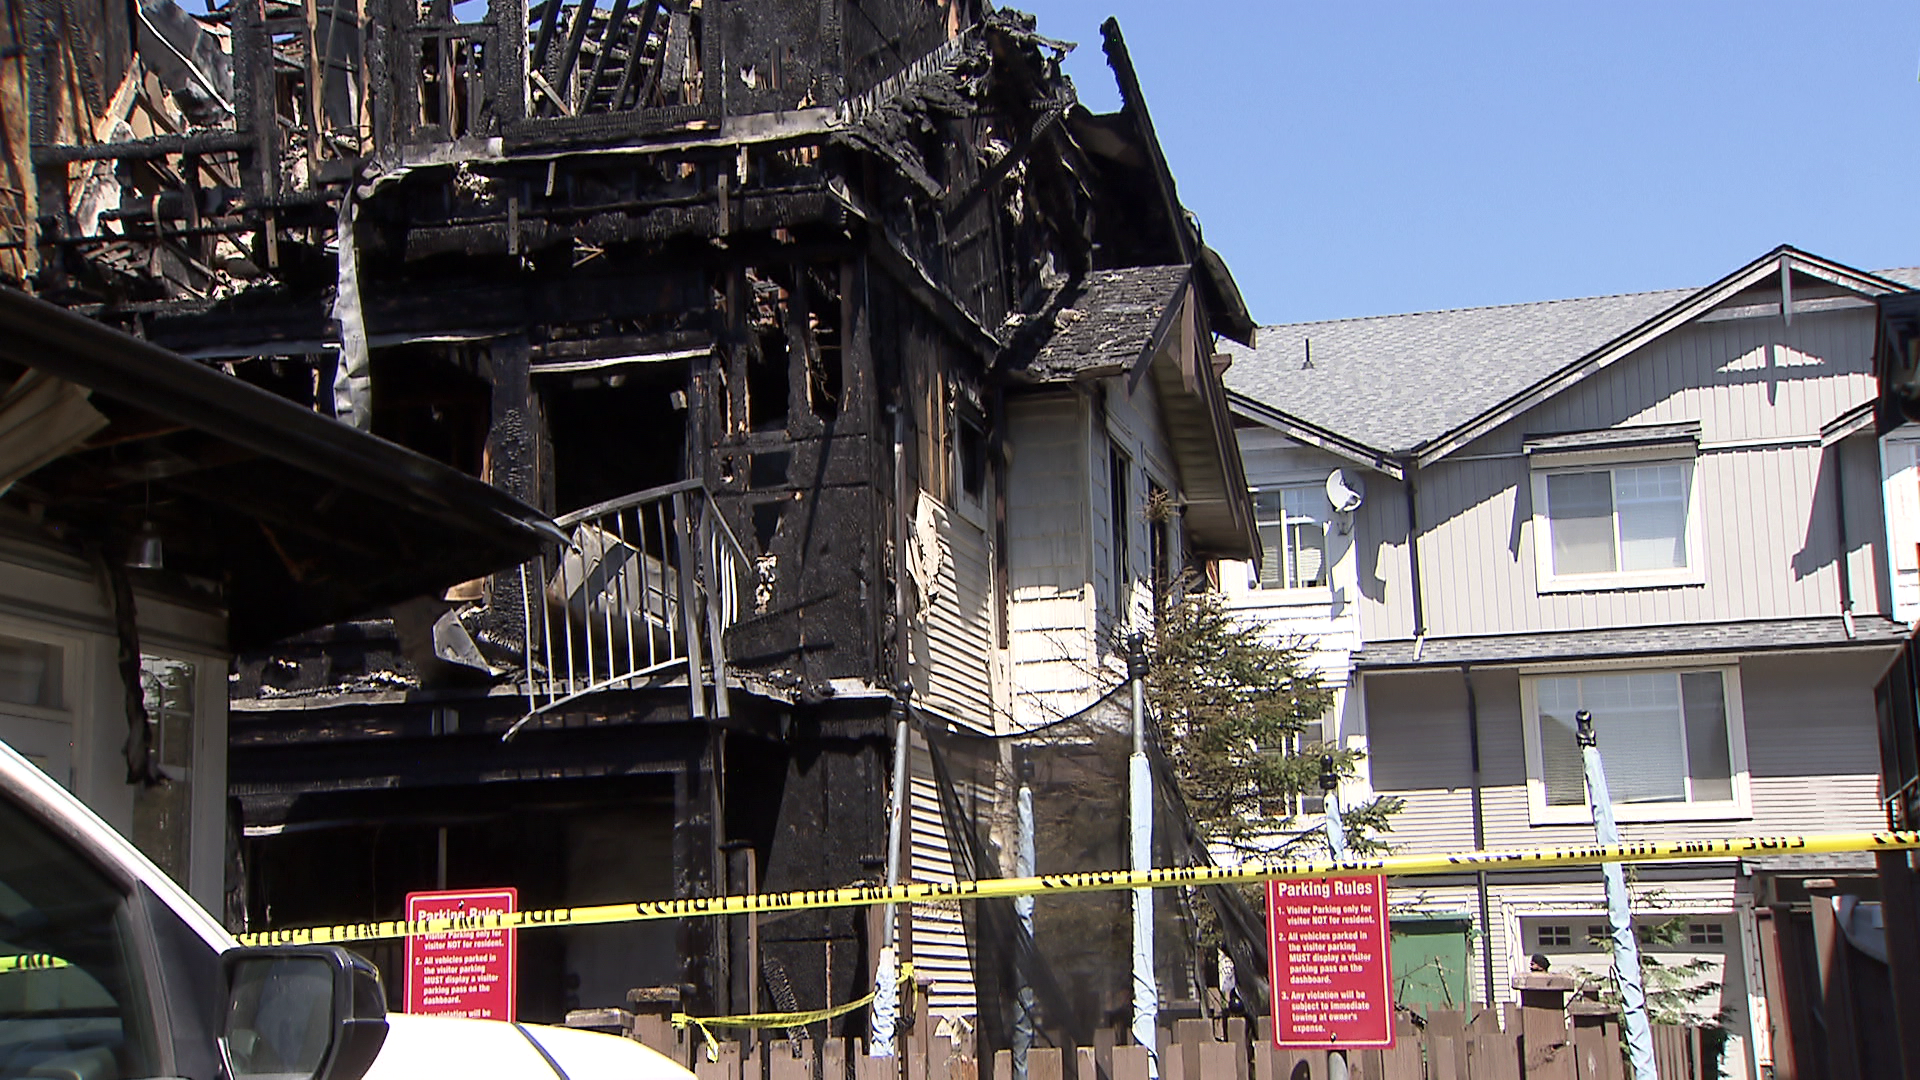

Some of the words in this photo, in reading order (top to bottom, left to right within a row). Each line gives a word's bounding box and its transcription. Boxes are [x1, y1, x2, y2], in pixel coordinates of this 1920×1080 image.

[1278, 882, 1330, 898] Parking
[1335, 882, 1372, 895] Rules
[1287, 906, 1311, 914] Visitor
[1313, 906, 1341, 915] Parking
[1343, 905, 1359, 914] only
[1361, 904, 1372, 912] for
[1288, 917, 1310, 925] visitor
[1312, 916, 1328, 924] NOT
[1329, 916, 1340, 924] for
[1342, 915, 1375, 924] resident.
[1279, 934, 1286, 942] 2.
[1288, 933, 1298, 941] All
[1300, 932, 1330, 940] vehicles
[1332, 931, 1358, 941] parked
[1360, 931, 1367, 939] in
[425, 942, 445, 950] visitor
[447, 941, 461, 949] NOT
[463, 940, 472, 948] for
[1289, 943, 1301, 952] the
[1303, 943, 1326, 951] visitor
[1328, 942, 1356, 952] parking
[464, 955, 488, 964] parked
[489, 954, 496, 962] in
[1290, 954, 1311, 962] MUST
[1312, 953, 1339, 963] display
[1348, 953, 1371, 961] visitor
[424, 966, 435, 974] the
[437, 965, 458, 973] visitor
[460, 964, 485, 973] parking
[1290, 964, 1318, 975] parking
[1320, 965, 1337, 974] pass
[1350, 963, 1362, 972] the
[424, 976, 444, 984] MUST
[445, 975, 470, 984] display
[478, 974, 498, 982] visitor
[1291, 975, 1332, 984] dashboard.
[424, 986, 449, 995] parking
[451, 985, 467, 994] pass
[479, 984, 490, 992] the
[424, 995, 461, 1005] dashboard.
[1291, 992, 1305, 1001] Any
[1307, 991, 1339, 999] violation
[1341, 991, 1354, 999] will
[1292, 1002, 1319, 1012] subject
[1331, 1001, 1370, 1010] immediate
[482, 1009, 491, 1017] be
[1293, 1013, 1317, 1022] towing
[1319, 1013, 1327, 1021] at
[1329, 1012, 1358, 1021] owner's
[1293, 1025, 1326, 1033] expense.
